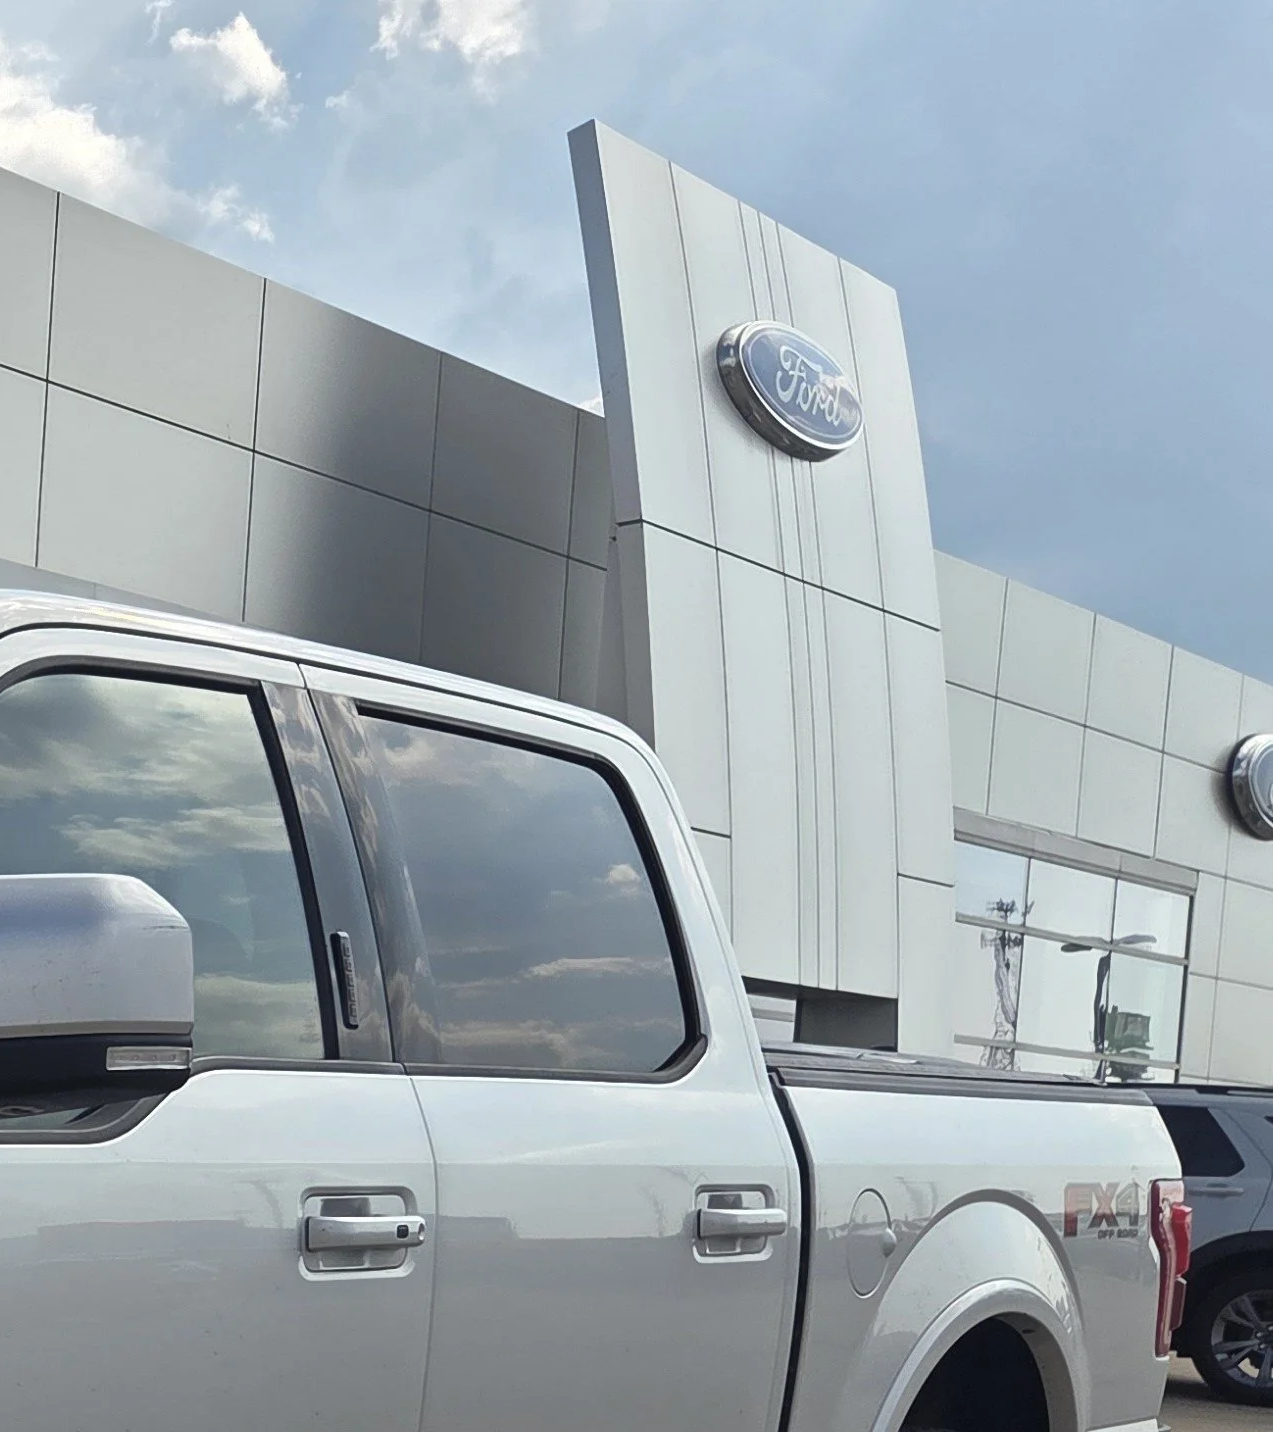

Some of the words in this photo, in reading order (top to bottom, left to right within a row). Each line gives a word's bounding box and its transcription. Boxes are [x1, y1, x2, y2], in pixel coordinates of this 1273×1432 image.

[776, 346, 842, 425] Ford
[1064, 1181, 1139, 1237] FX4
[1097, 1229, 1115, 1240] OFF
[1117, 1228, 1138, 1238] ROAD
